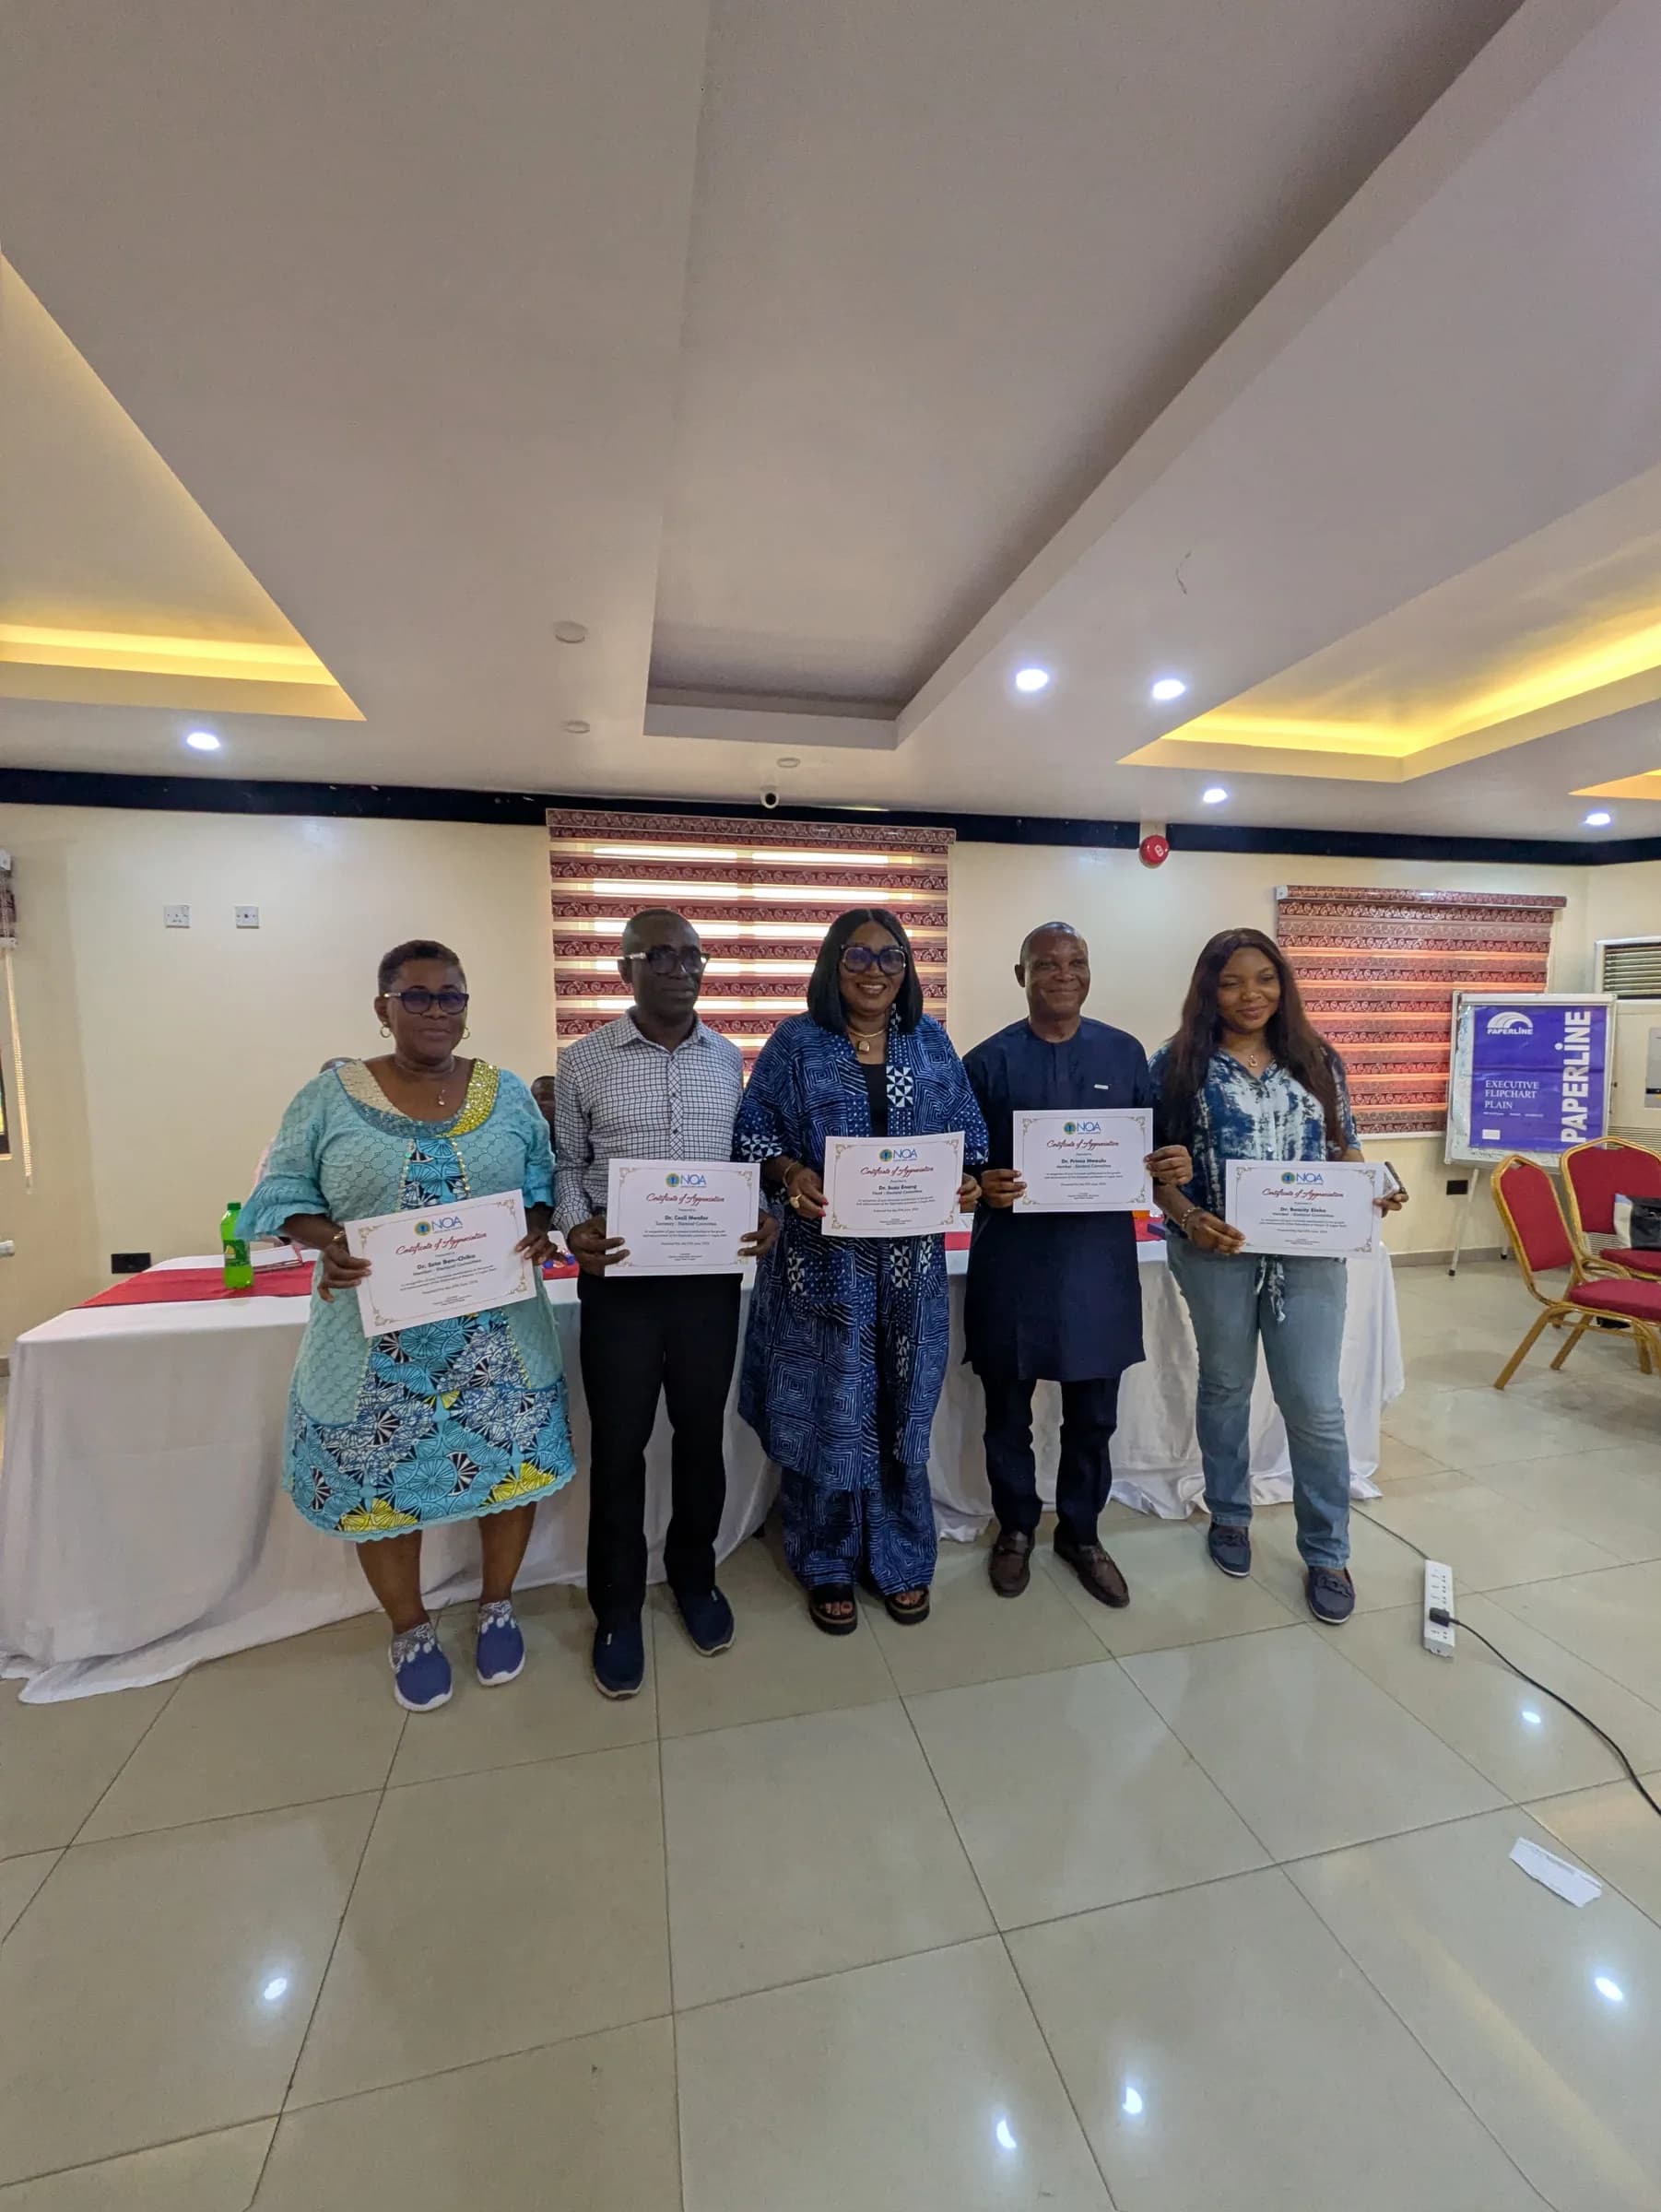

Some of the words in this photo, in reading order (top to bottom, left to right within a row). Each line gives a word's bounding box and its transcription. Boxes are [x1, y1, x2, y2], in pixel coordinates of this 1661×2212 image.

[1486, 1080, 1539, 1088] EXECUTIVE
[1485, 1089, 1537, 1099] FLIPCHART
[1485, 1100, 1513, 1109] PLAIN
[1047, 1139, 1075, 1149] Certificate
[1076, 1139, 1084, 1149] of
[1082, 1139, 1119, 1150] Appreciation
[861, 1167, 889, 1177] Certificate
[890, 1167, 899, 1176] of
[897, 1166, 934, 1177] Appreciation
[646, 1193, 677, 1204] Certificate
[678, 1194, 687, 1205] of
[686, 1194, 724, 1206] Appreciation
[1262, 1188, 1293, 1197] Certificate
[1295, 1189, 1303, 1198] of
[1302, 1190, 1344, 1200] Appreciation
[396, 1242, 432, 1254] Certificate
[434, 1239, 442, 1250] of
[442, 1233, 487, 1250] Appreciation
